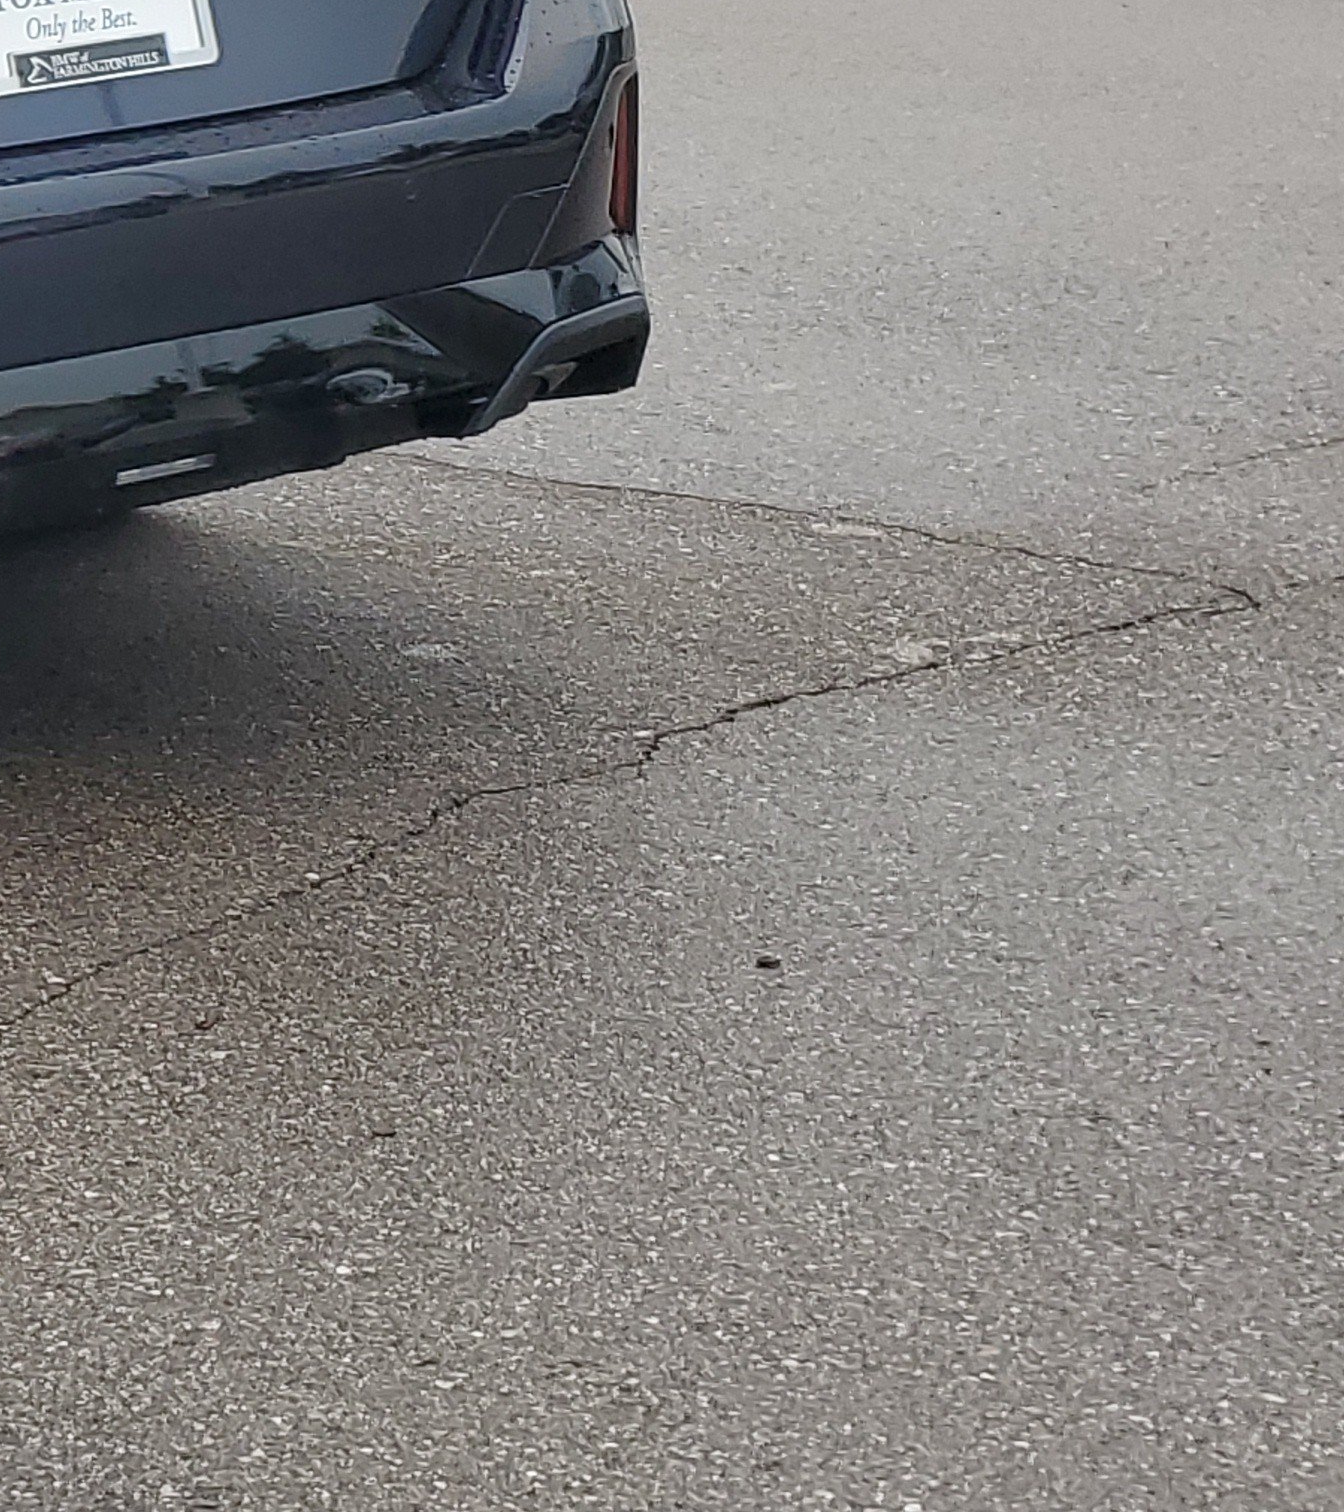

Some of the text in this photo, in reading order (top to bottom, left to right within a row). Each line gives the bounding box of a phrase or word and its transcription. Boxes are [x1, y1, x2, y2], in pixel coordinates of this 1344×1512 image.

[26, 8, 138, 43] Only the Best.
